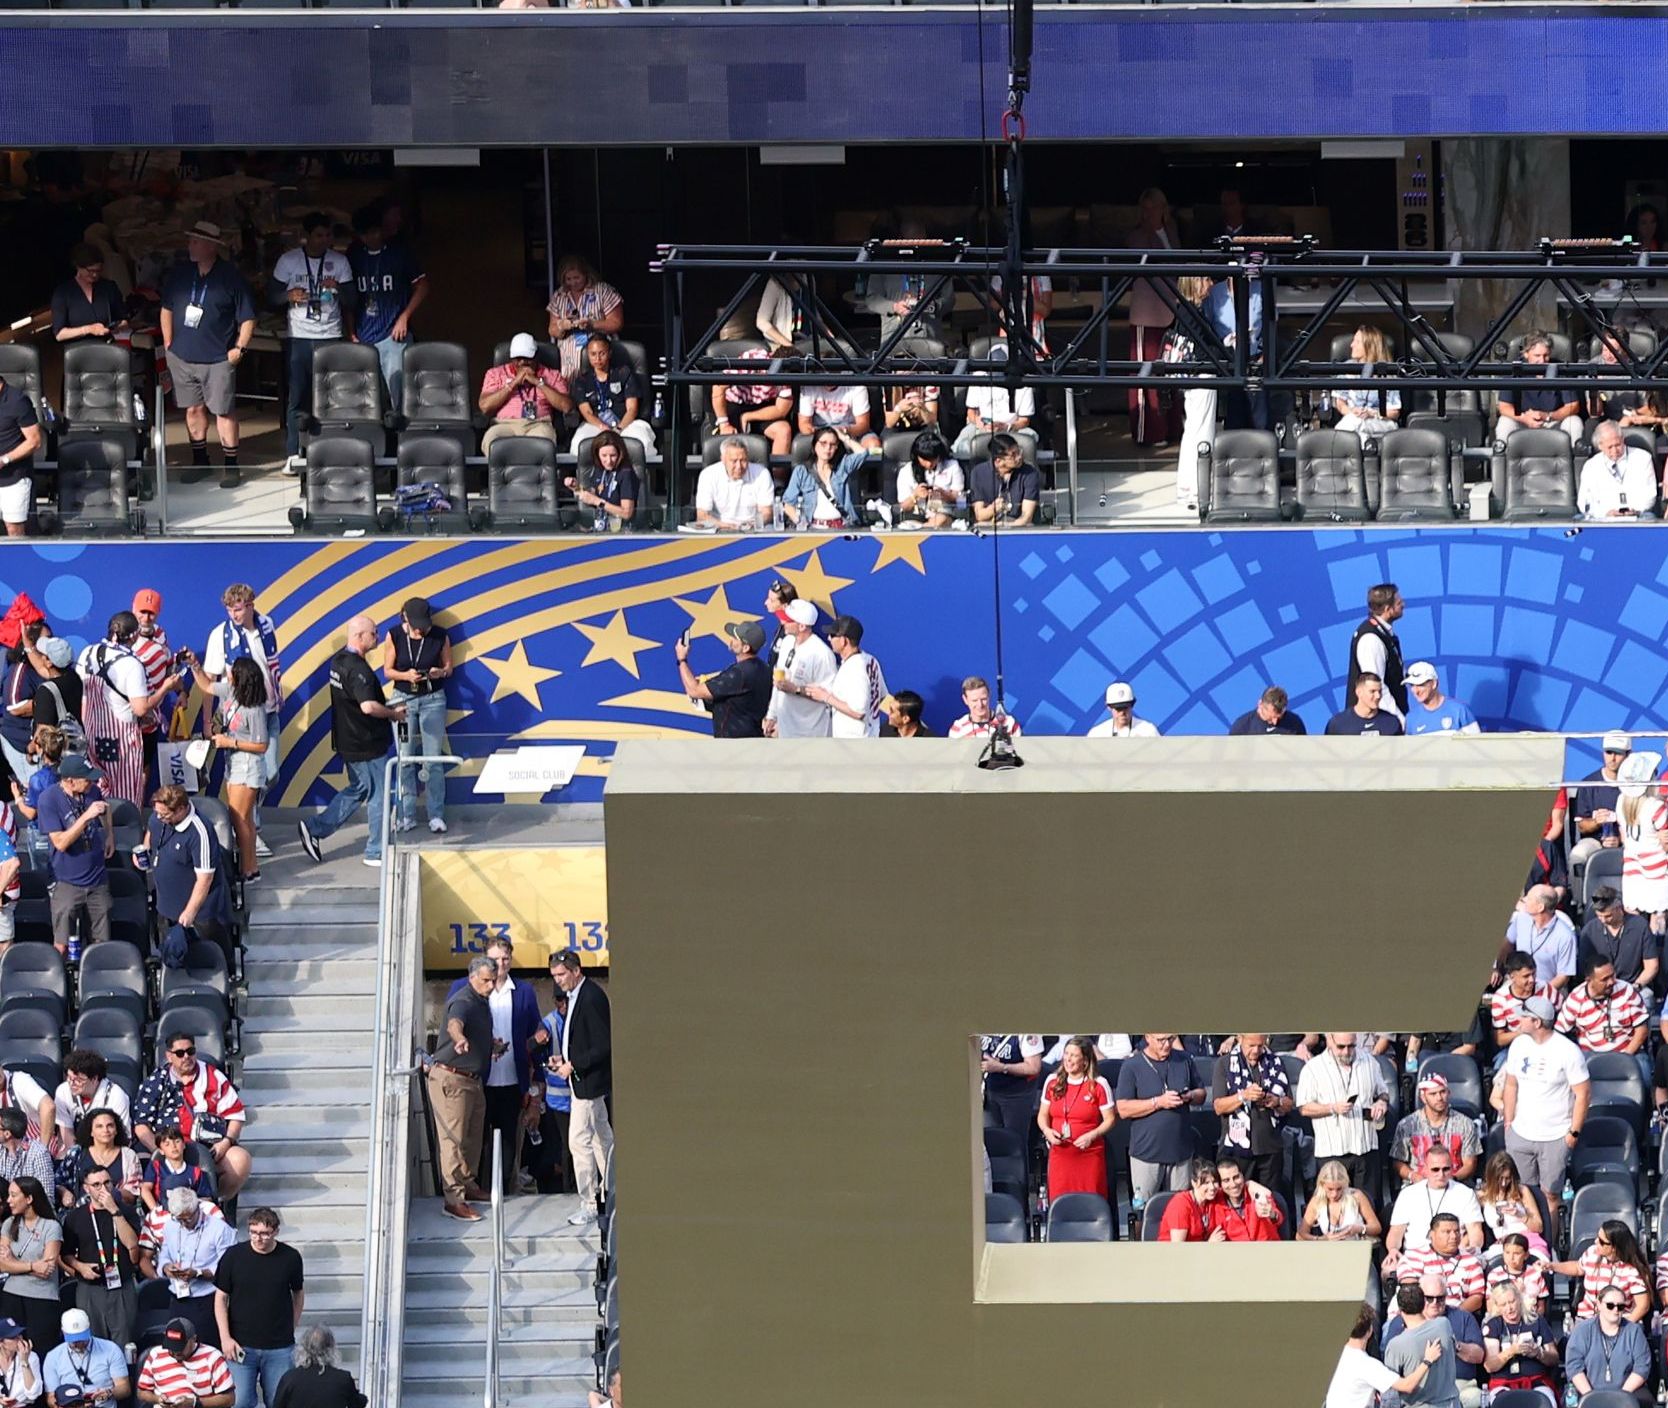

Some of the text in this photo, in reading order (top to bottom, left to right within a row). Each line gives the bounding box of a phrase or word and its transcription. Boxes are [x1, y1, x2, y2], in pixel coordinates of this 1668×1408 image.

[357, 274, 394, 292] USA
[508, 769, 566, 780] SOCIAL CLUB
[451, 922, 609, 953] 133 13
